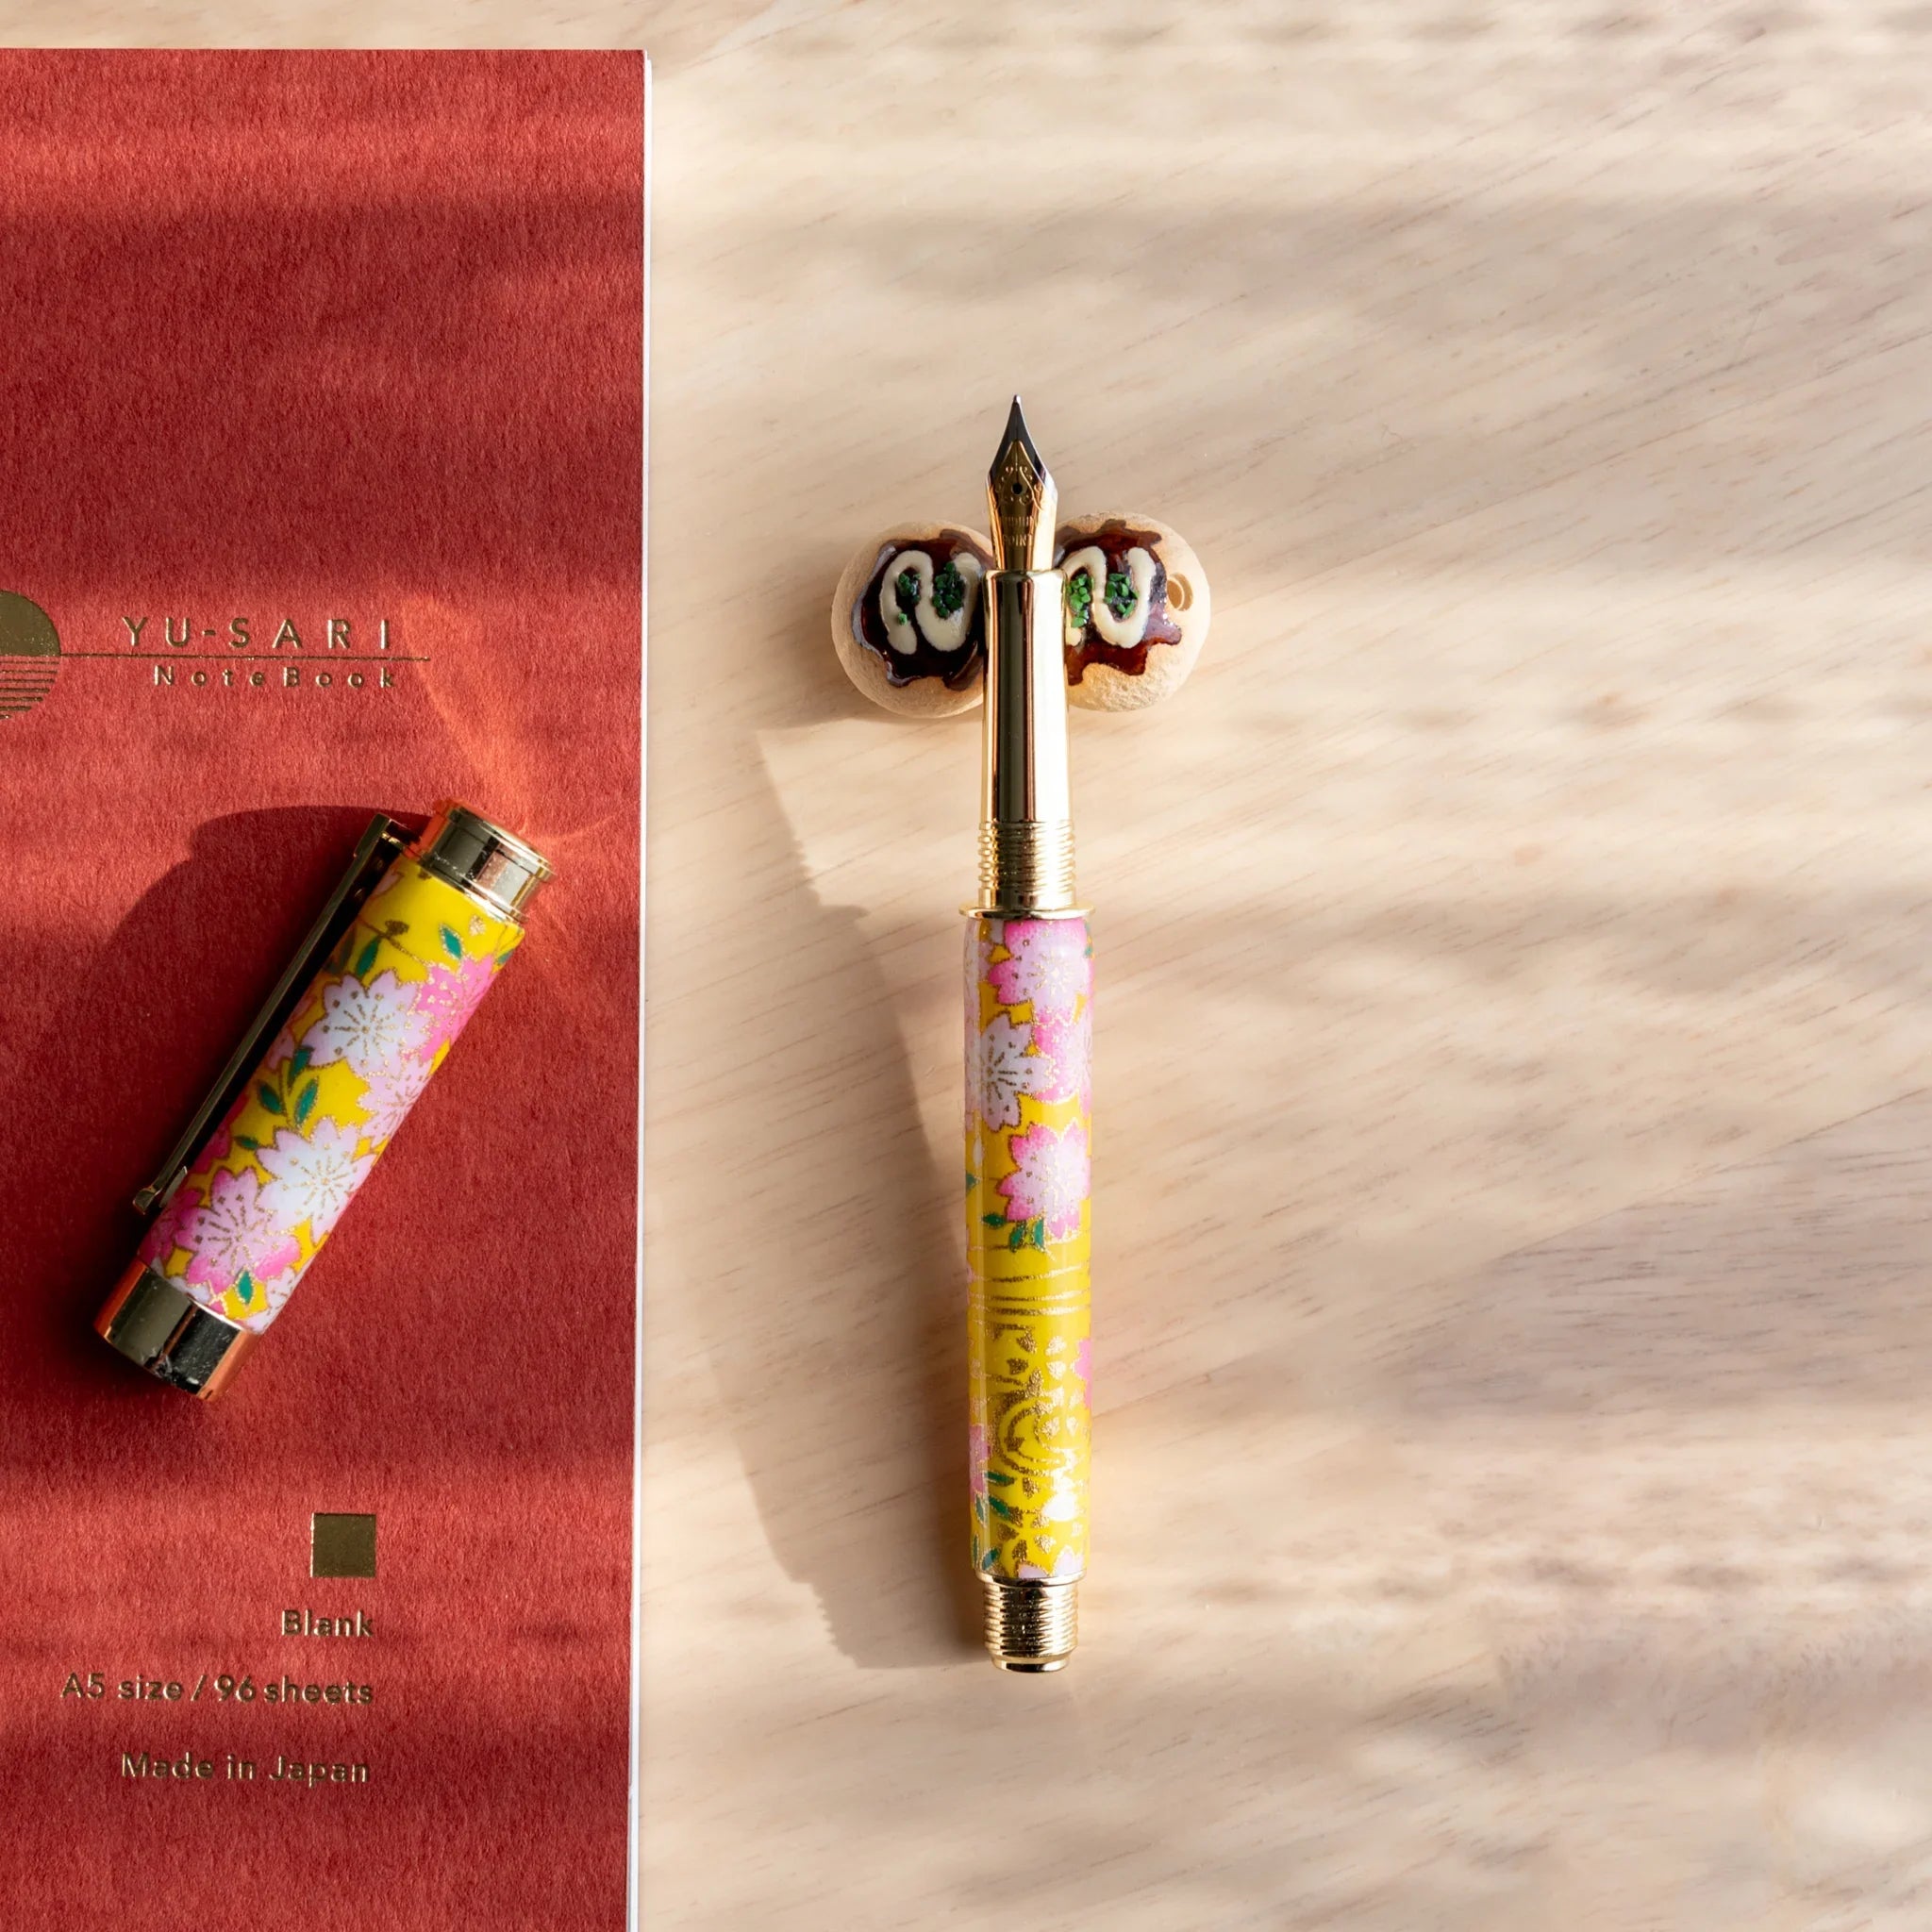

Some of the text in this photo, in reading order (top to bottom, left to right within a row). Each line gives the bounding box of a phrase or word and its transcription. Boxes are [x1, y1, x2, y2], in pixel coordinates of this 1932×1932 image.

[123, 617, 391, 649] YU-SARI
[154, 665, 394, 688] NoteBook
[282, 1609, 373, 1638] Blank
[60, 1673, 374, 1705] A5 size / 96 sheets
[122, 1752, 370, 1788] Made in Japan
